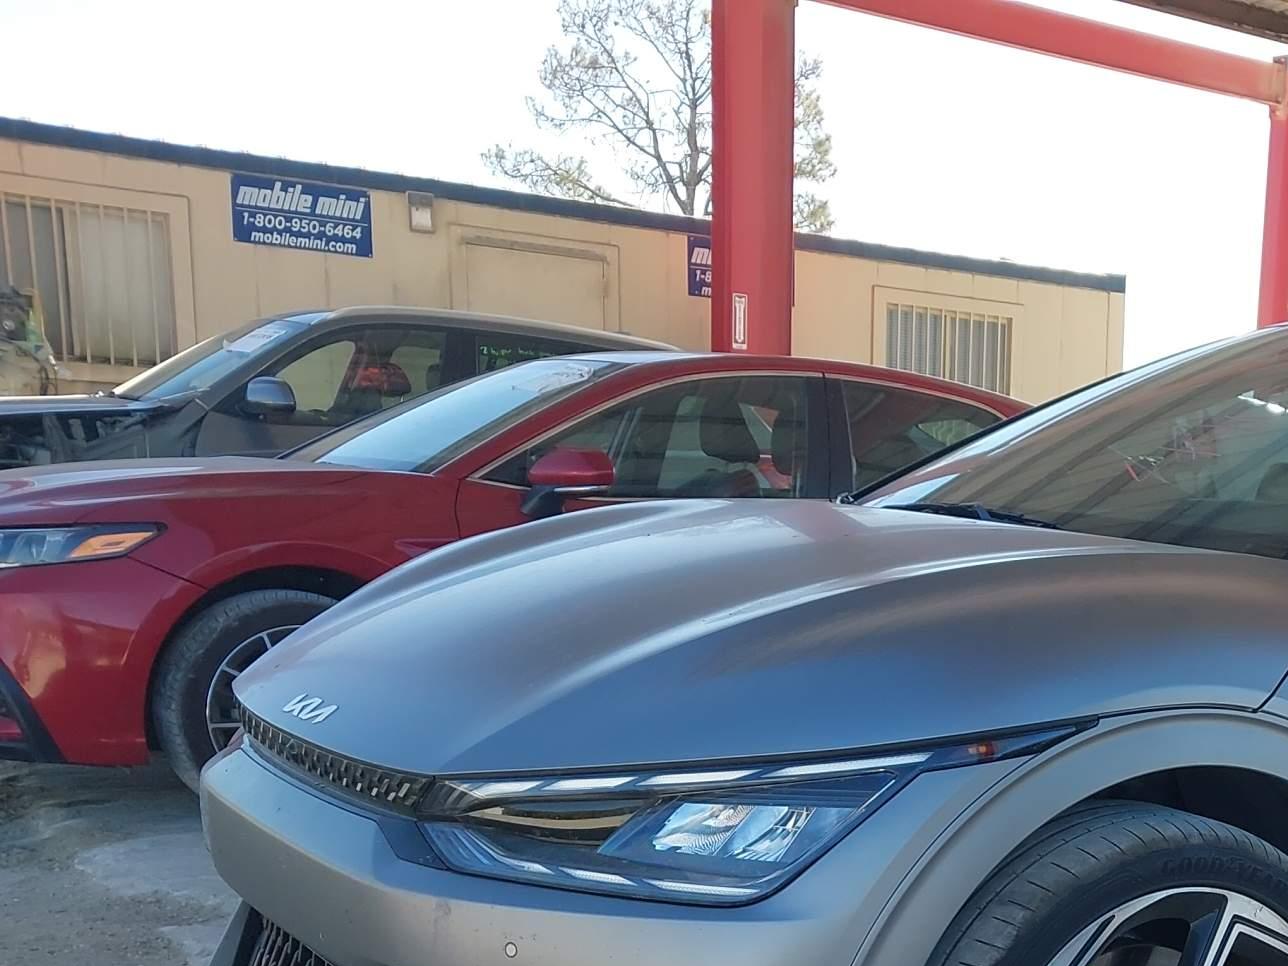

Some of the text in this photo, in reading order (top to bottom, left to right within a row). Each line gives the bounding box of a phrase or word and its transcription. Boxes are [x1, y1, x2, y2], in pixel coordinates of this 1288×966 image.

[236, 181, 367, 220] mobile mini
[242, 211, 362, 240] 1-800-950-6464
[251, 231, 357, 254] mobilemini.com
